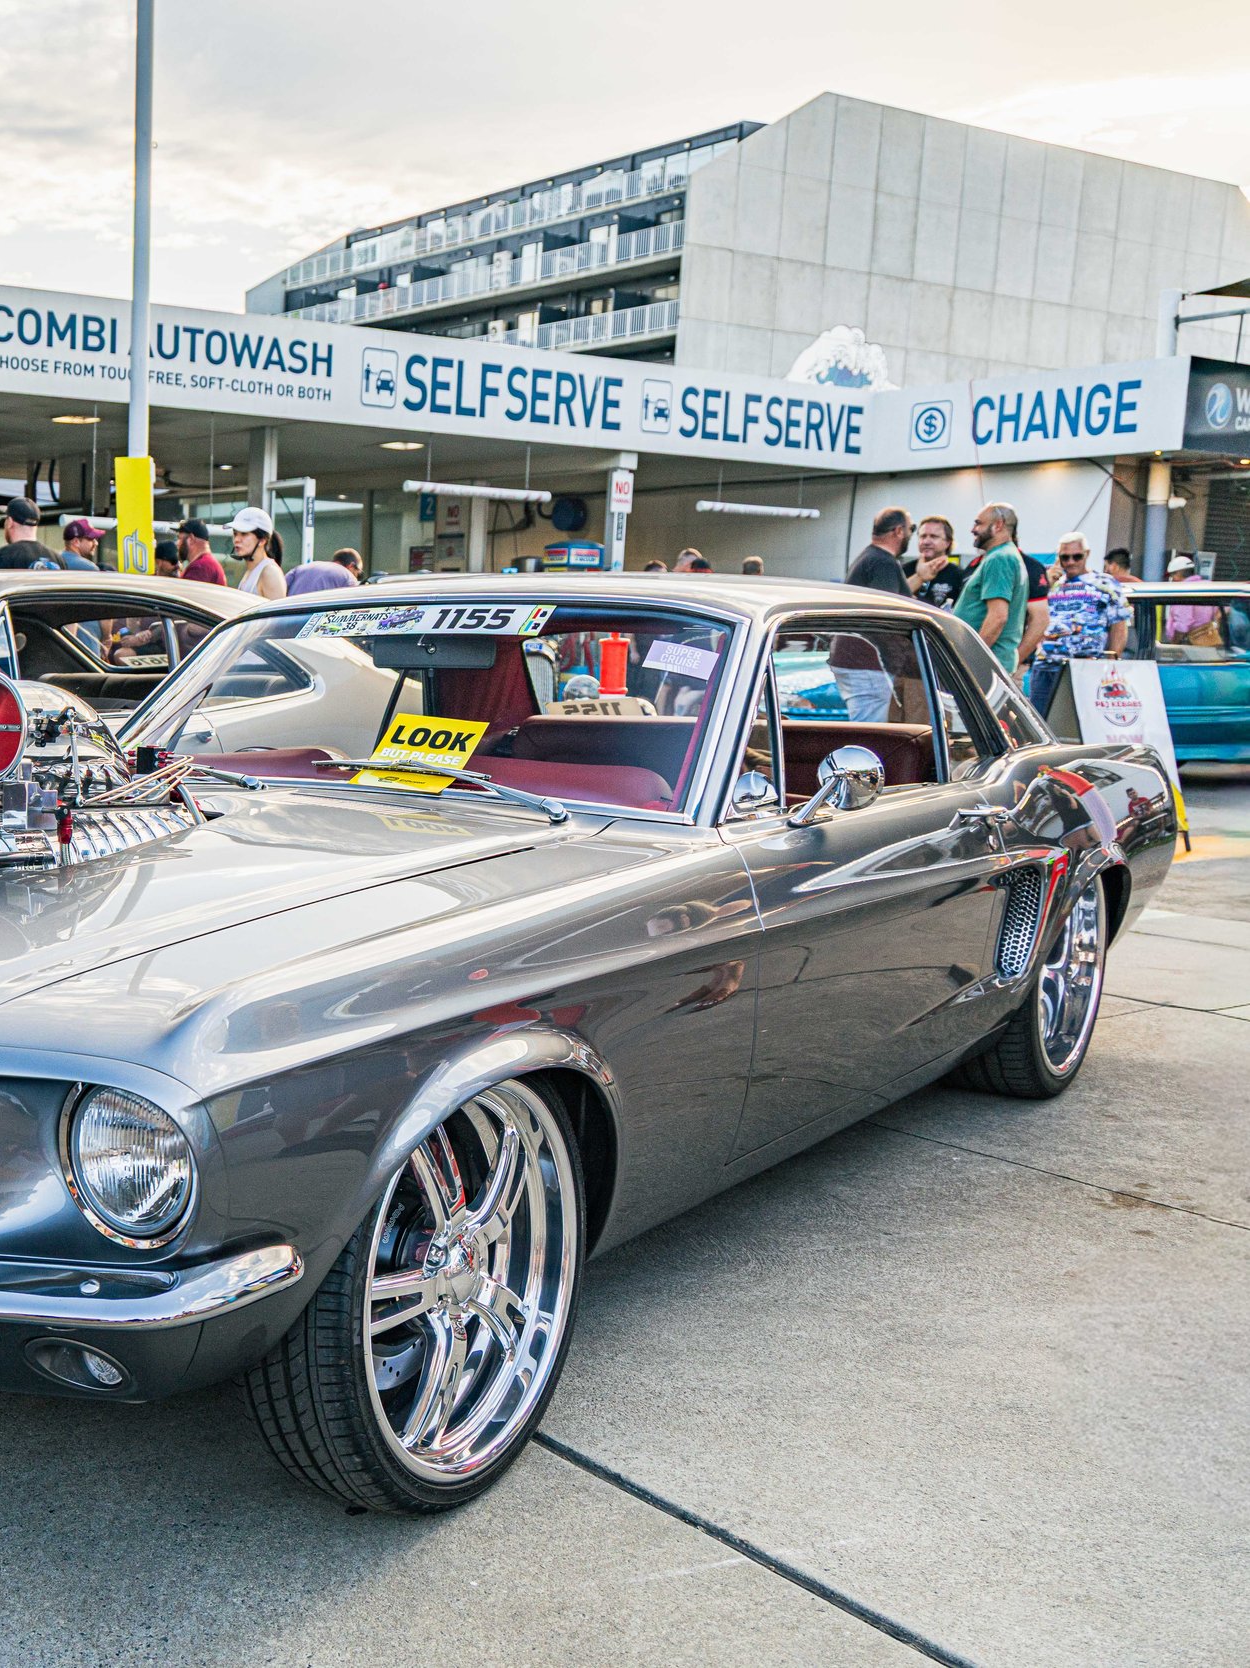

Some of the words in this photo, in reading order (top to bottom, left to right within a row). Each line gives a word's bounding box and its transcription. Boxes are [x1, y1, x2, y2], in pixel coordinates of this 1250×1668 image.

[53, 360, 95, 377] FROM
[100, 364, 132, 380] TOU
[190, 374, 274, 396] SOFT-CLOTH
[276, 380, 295, 397] OR
[297, 384, 332, 401] BOTH
[403, 354, 624, 431] SELFSERVE
[679, 386, 865, 455] SELFSERVE
[973, 380, 1142, 445] CHANGE
[616, 481, 630, 495] NO
[426, 497, 434, 515] 2
[327, 612, 389, 624] SUMMERNATS
[342, 622, 358, 631] 38
[432, 608, 517, 630] 1155
[660, 654, 701, 669] CRUISE
[665, 645, 702, 660] SUPER
[390, 725, 476, 752] LOOK
[380, 748, 409, 759] BUT
[409, 751, 462, 766] PLEASE
